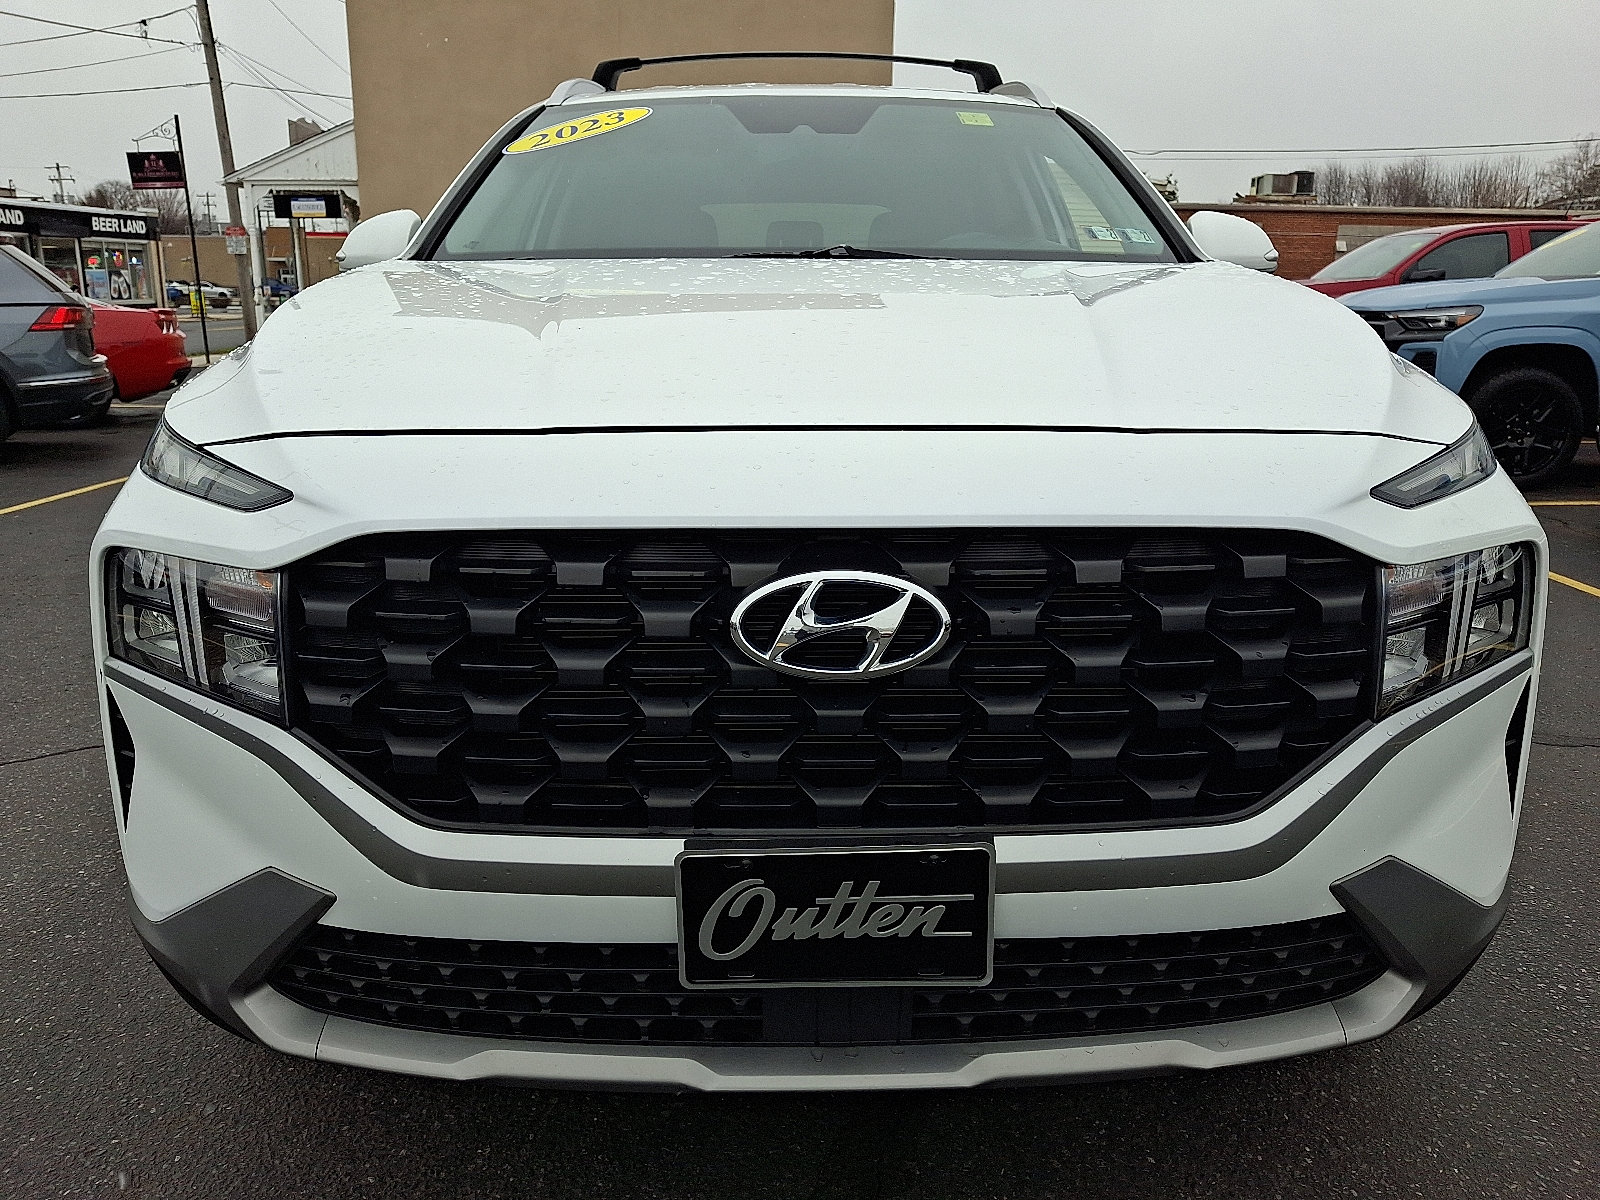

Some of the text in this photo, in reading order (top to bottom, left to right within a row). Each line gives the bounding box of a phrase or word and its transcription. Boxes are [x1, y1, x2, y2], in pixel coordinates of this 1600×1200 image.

[528, 111, 625, 148] 2023
[91, 216, 147, 234] BEER LAND
[698, 878, 975, 961] Outten
